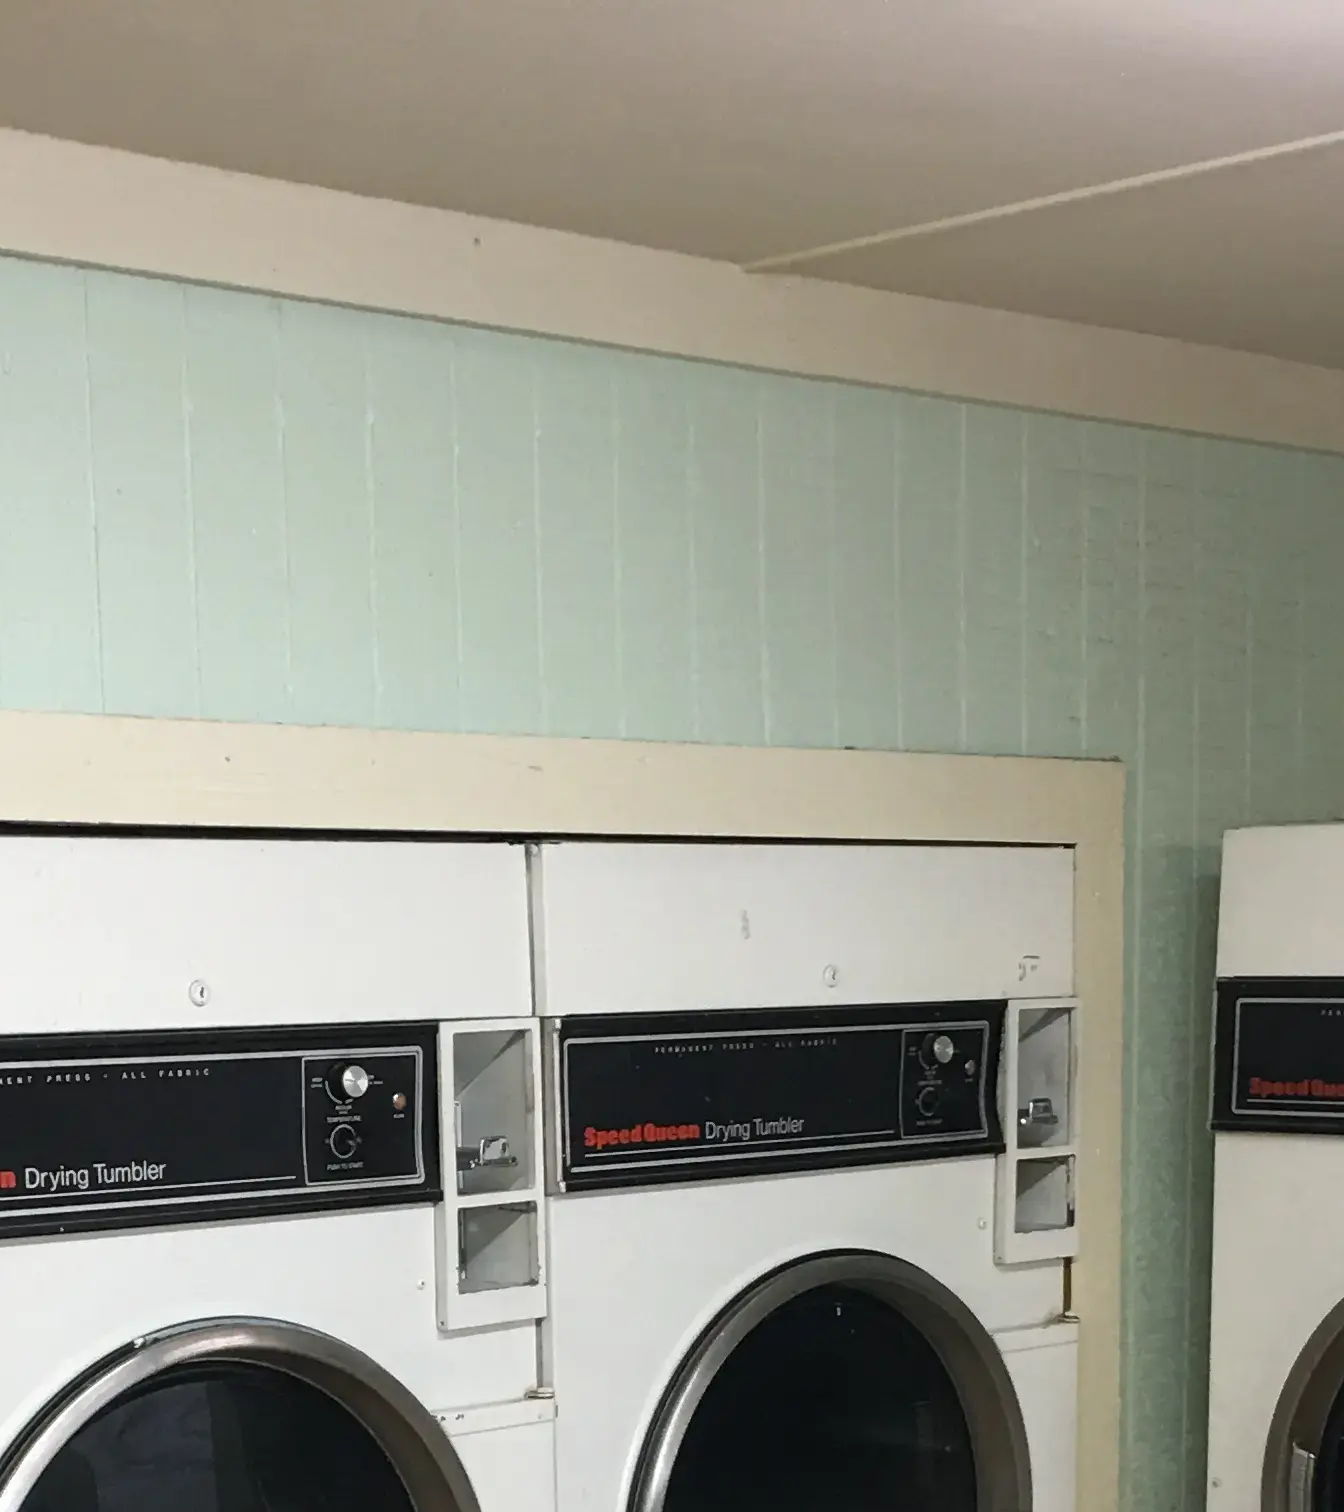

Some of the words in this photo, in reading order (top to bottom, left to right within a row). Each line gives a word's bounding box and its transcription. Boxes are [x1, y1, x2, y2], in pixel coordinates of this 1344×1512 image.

[1249, 1077, 1309, 1099] Speed
[584, 1124, 642, 1149] Speed
[643, 1123, 701, 1142] Queen
[705, 1120, 751, 1142] Drying
[753, 1117, 805, 1136] Tumbler
[24, 1165, 89, 1191] Drying
[93, 1160, 166, 1184] Tumbler
